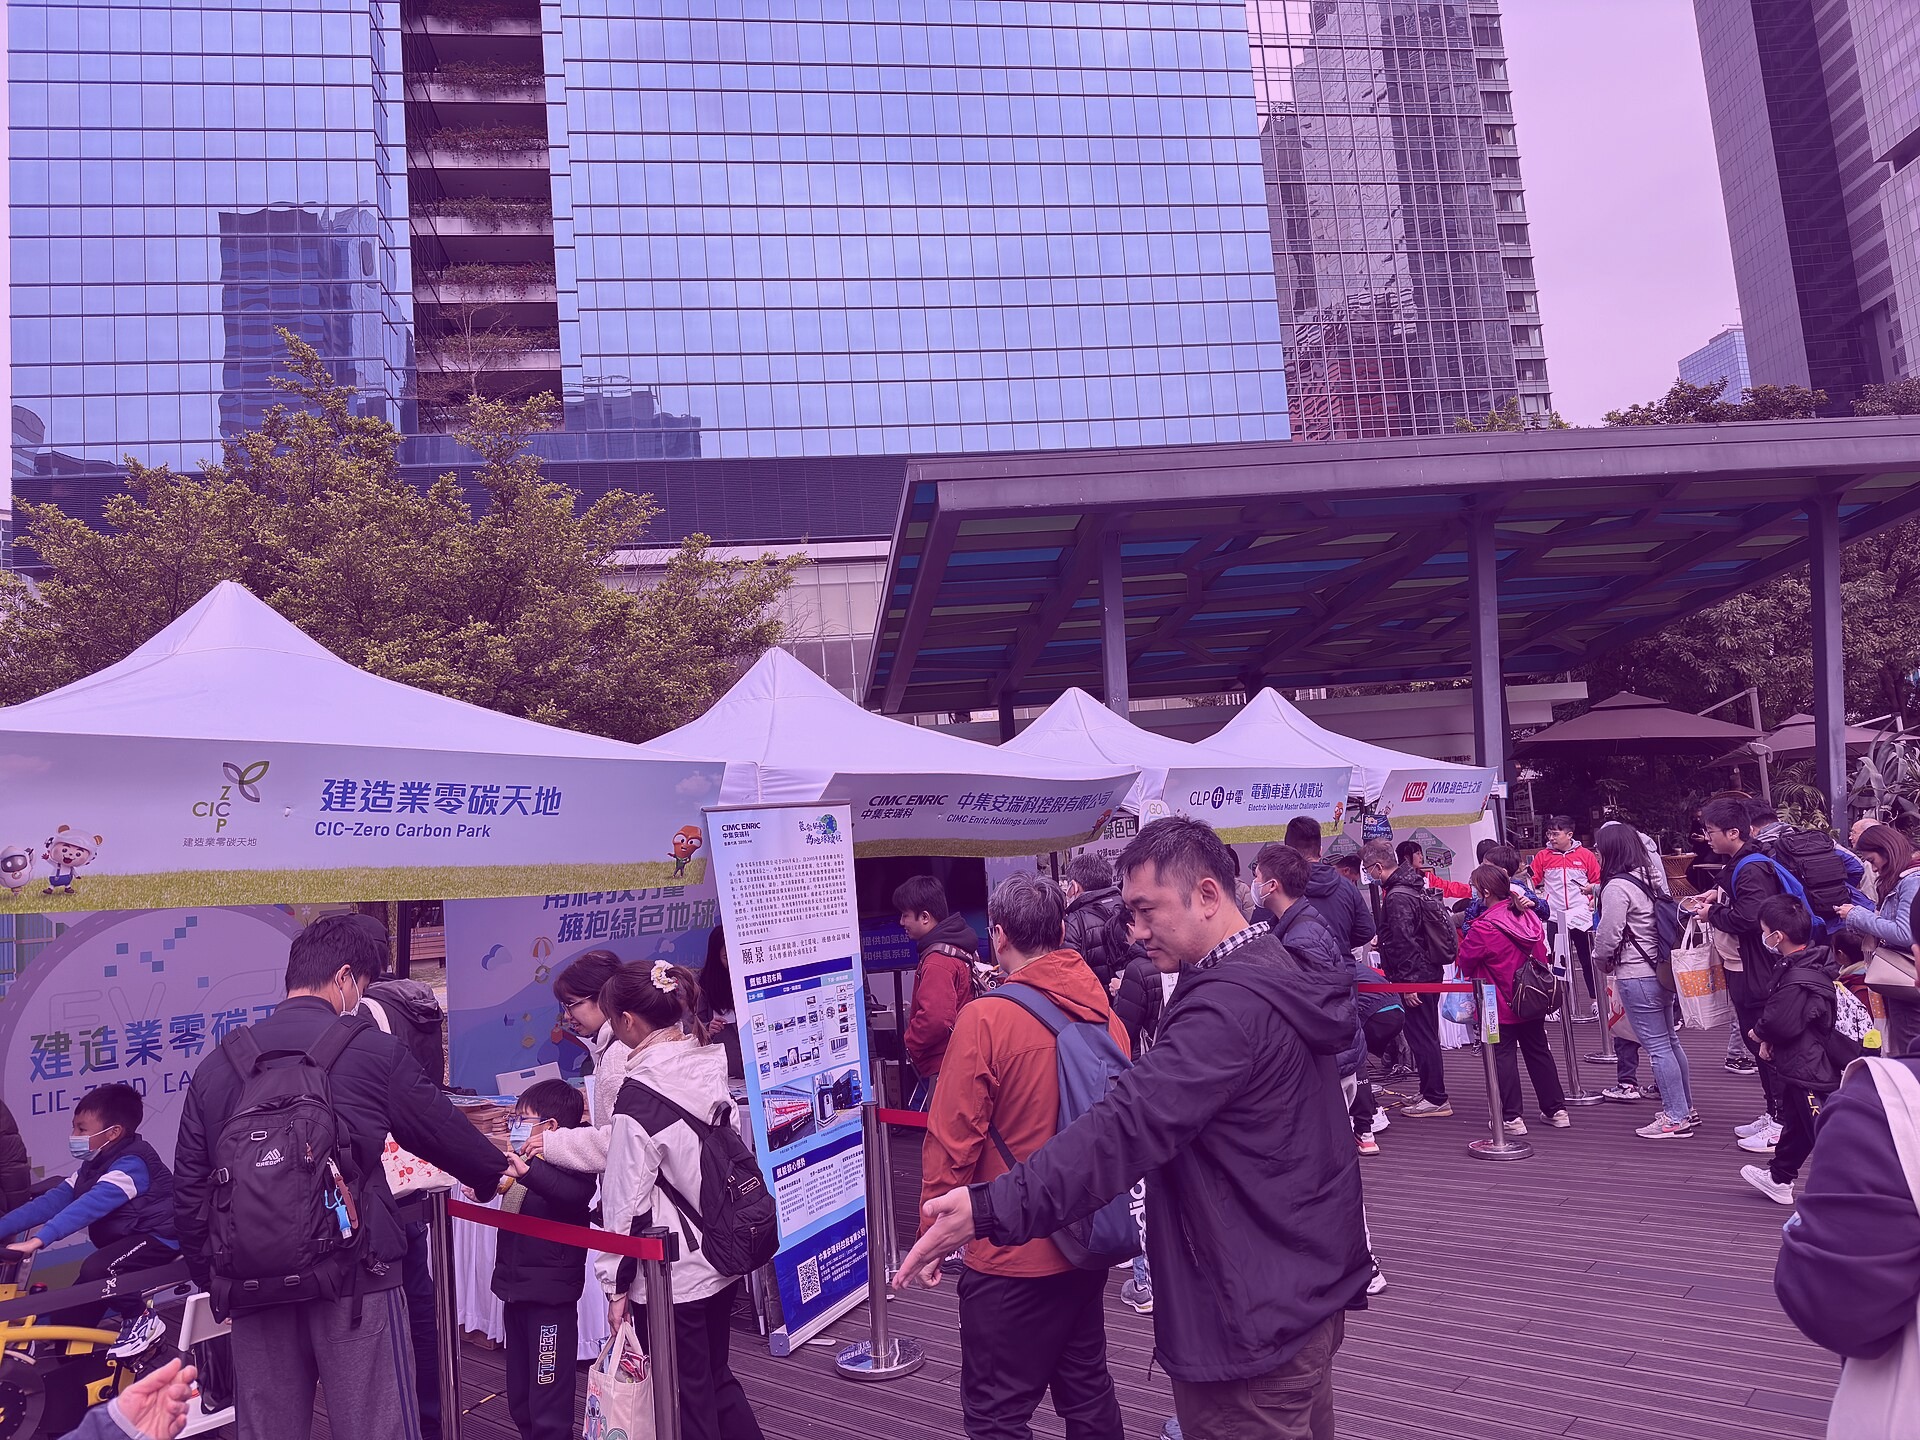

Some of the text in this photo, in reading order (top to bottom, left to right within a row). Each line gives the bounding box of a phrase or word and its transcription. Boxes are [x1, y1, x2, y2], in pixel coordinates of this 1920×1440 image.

[319, 778, 562, 816] 建造業零碳天地
[1189, 789, 1244, 806] CLP 中電
[1250, 781, 1324, 801] 電動車達人挑戰站
[1401, 781, 1428, 803] KMB
[868, 794, 949, 807] CIMC ENRIC
[956, 790, 1114, 815] 中集安瑞科控股有限公司
[1149, 803, 1163, 815] GO
[1248, 800, 1331, 812] Electric Vehicle Master Challenge Station
[860, 807, 914, 820] 中集安瑞科
[946, 814, 1049, 827] CIMC Enric Holdings Limited
[314, 821, 492, 839] CIC-Zero Carbon Park
[721, 822, 762, 833] CIMC ENRIC
[182, 837, 258, 848] 建造業零碳天地
[557, 898, 718, 944] 擁抱綠色地球
[537, 1324, 558, 1385] REBUILD
